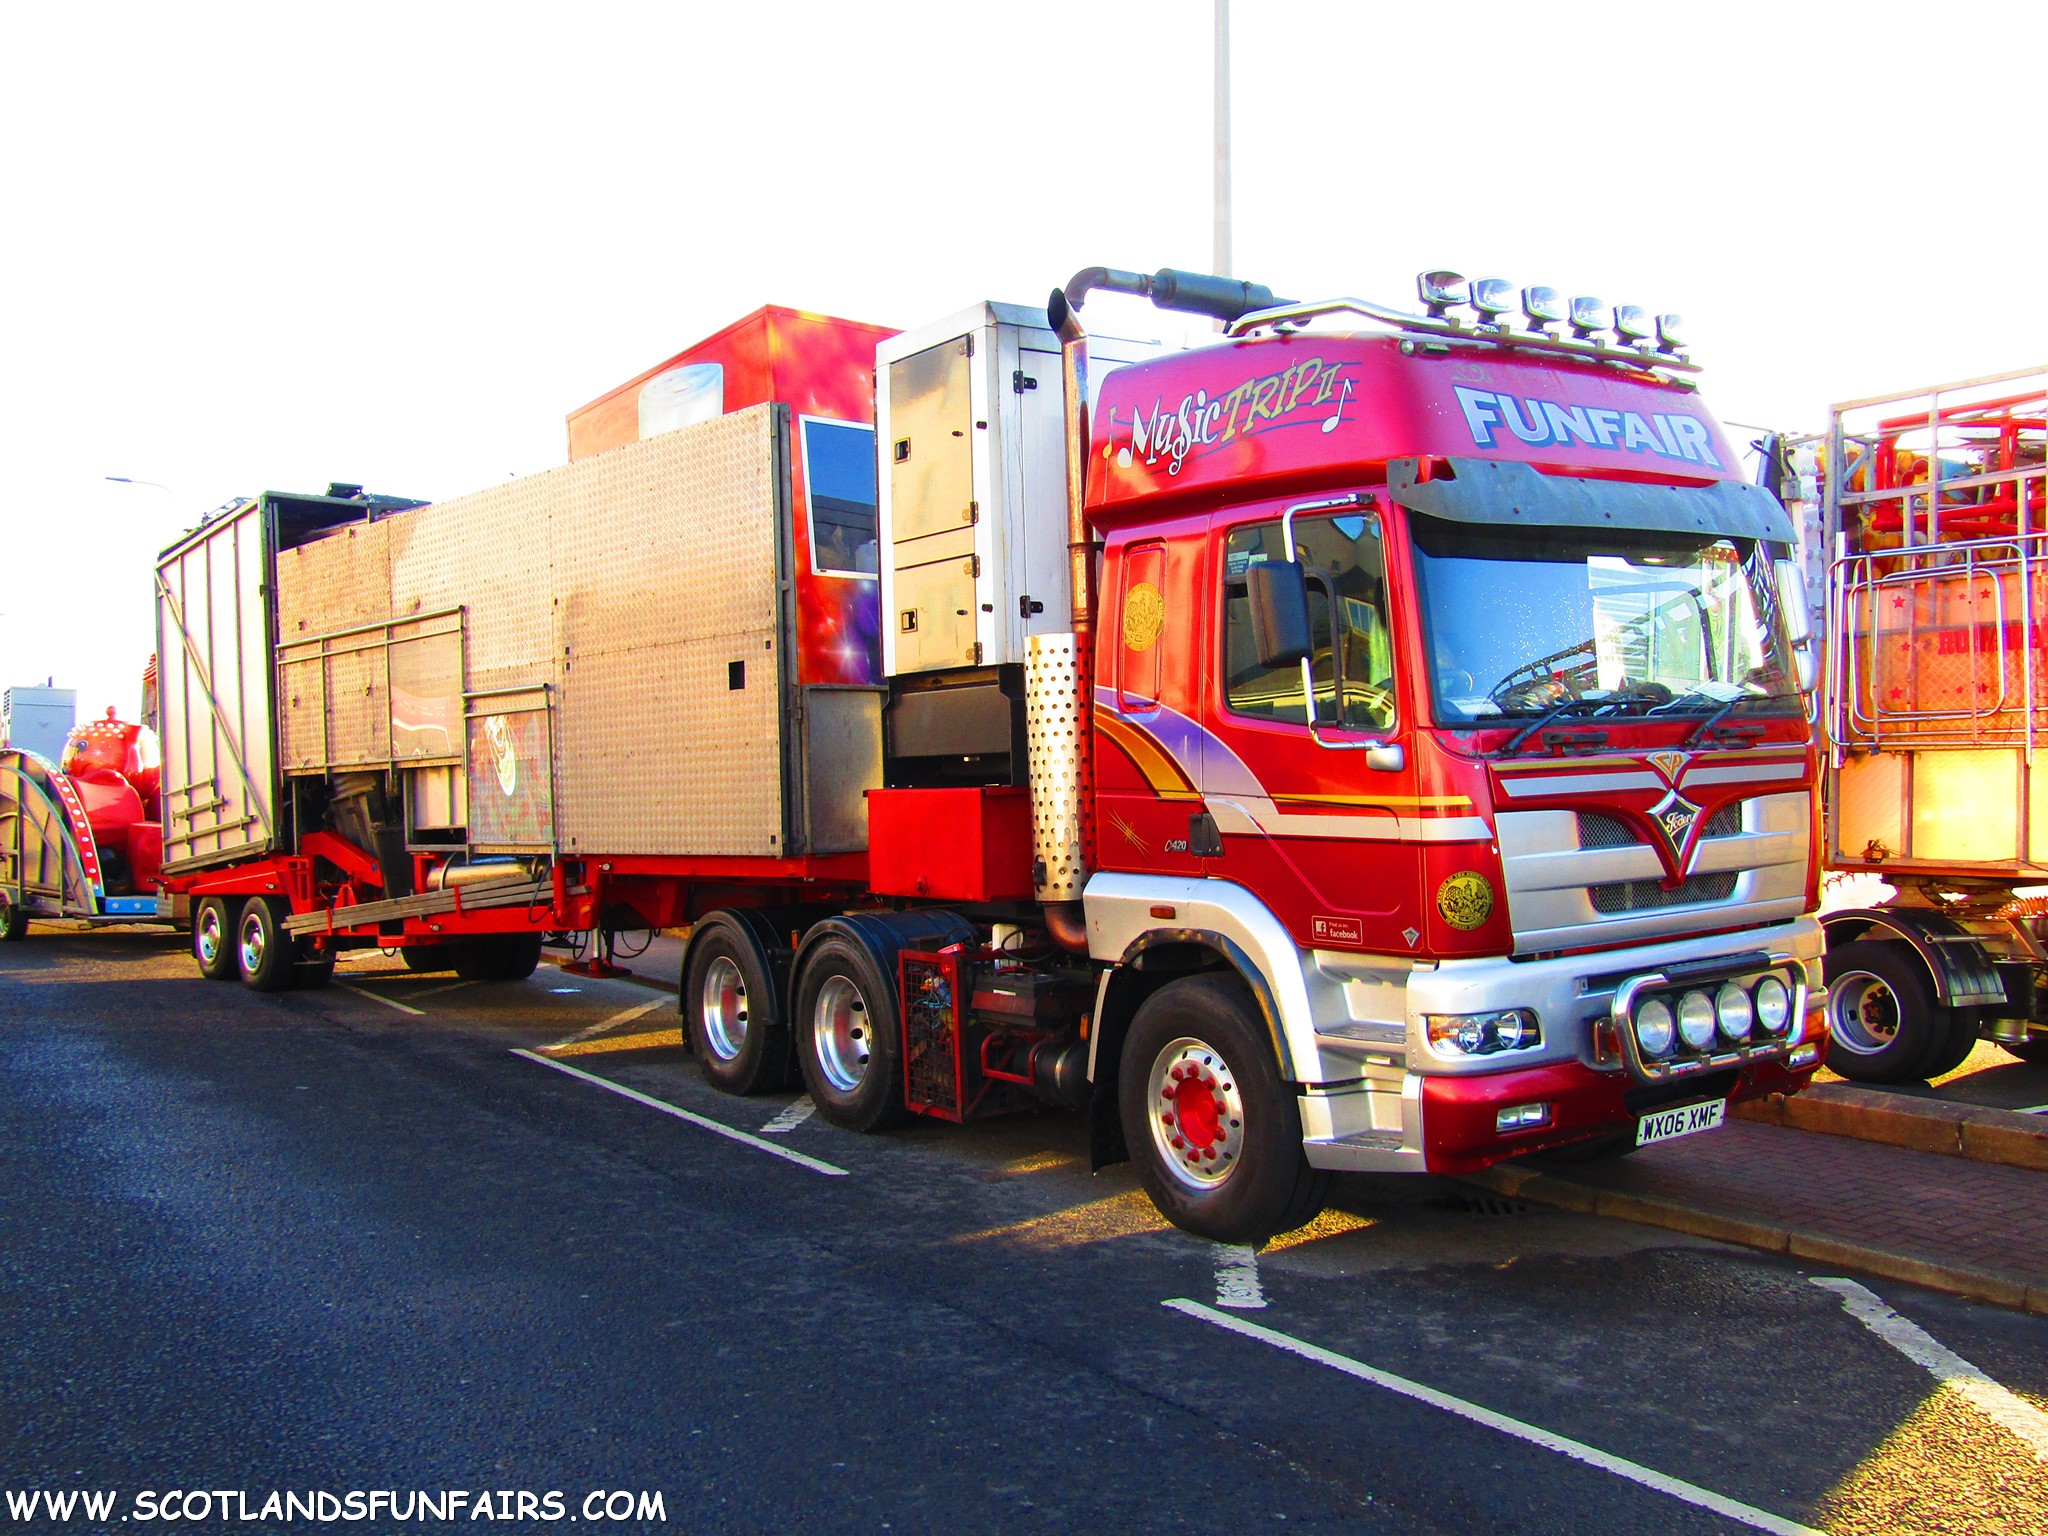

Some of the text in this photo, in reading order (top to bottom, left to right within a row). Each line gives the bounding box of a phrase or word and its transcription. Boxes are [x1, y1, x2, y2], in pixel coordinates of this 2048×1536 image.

[1452, 384, 1724, 470] FUNFAIR
[1164, 839, 1187, 853] C420
[1329, 928, 1359, 940] facebook
[1643, 1103, 1719, 1140] WX06 XMF
